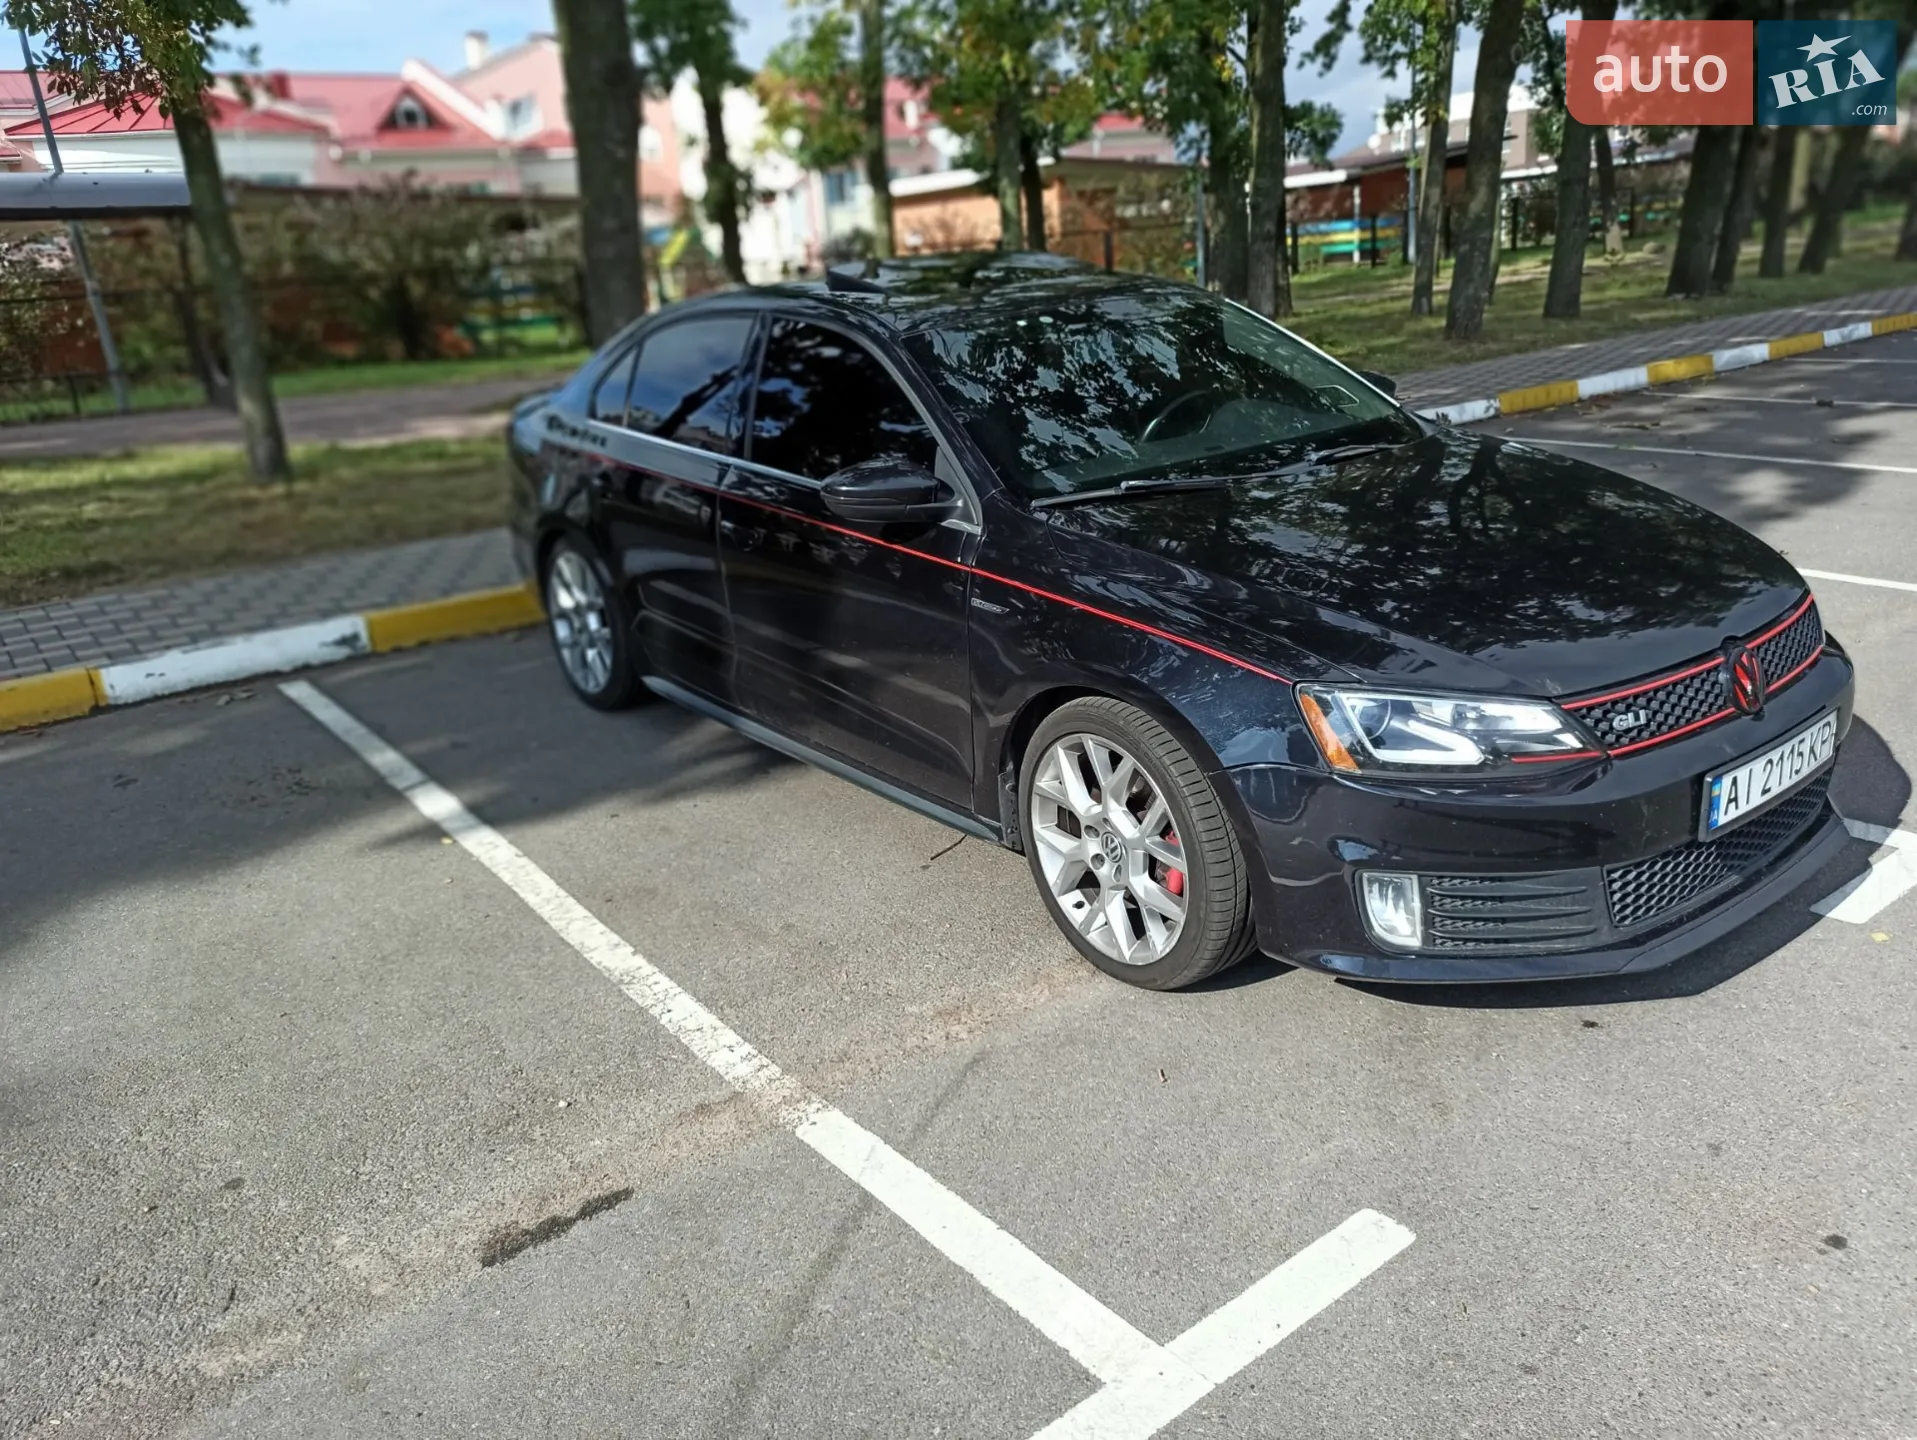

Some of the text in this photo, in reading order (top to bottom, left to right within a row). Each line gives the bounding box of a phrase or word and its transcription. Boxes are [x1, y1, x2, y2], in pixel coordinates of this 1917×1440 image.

[1612, 709, 1647, 731] GLI
[1724, 767, 1753, 817] AI
[1760, 737, 1806, 797] 2115
